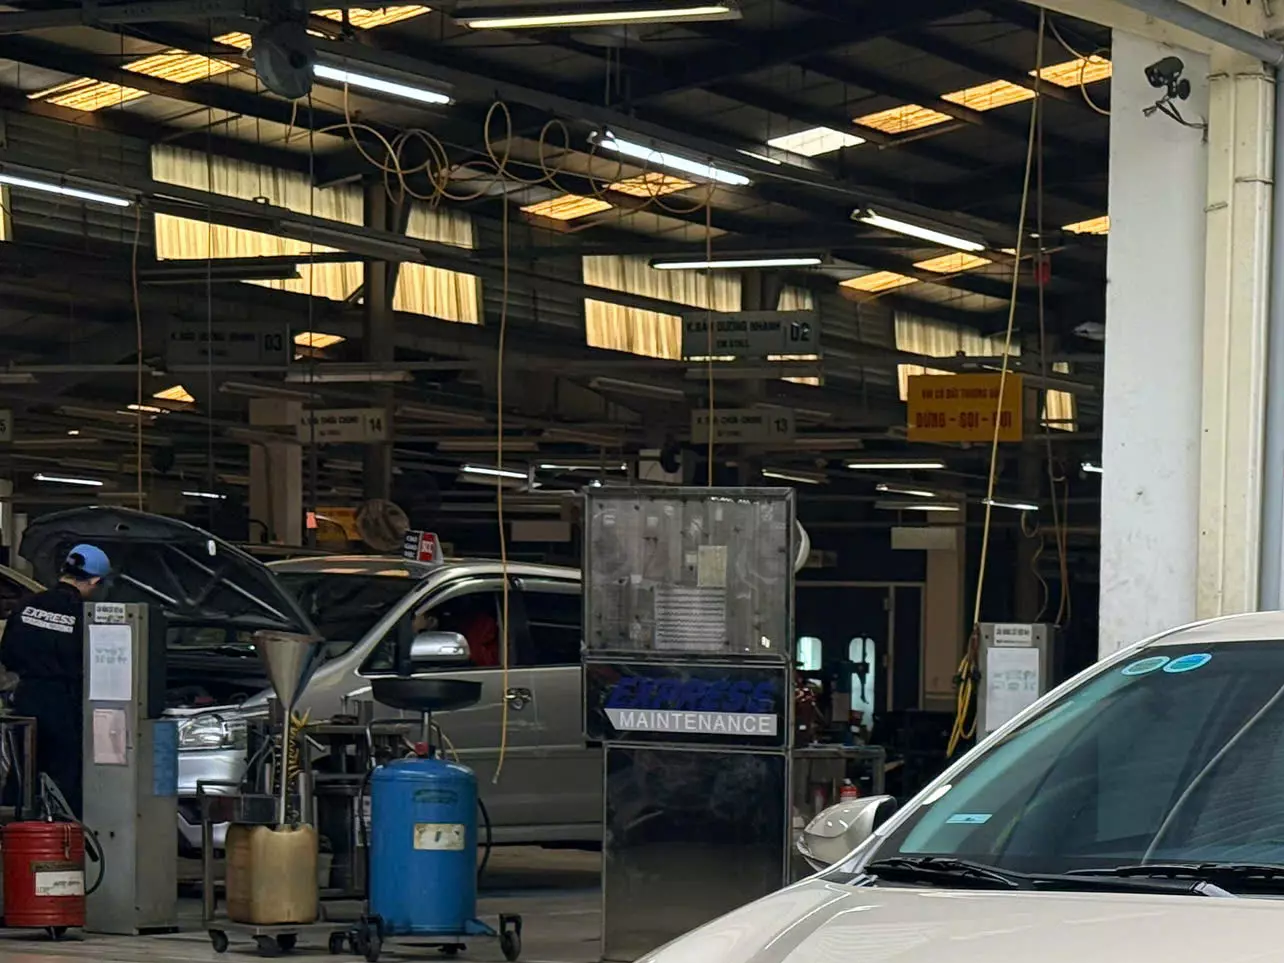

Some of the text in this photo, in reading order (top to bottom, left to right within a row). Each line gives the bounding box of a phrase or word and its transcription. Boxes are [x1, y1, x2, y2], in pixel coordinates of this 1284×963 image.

[773, 417, 788, 433] 13
[22, 606, 76, 625] EXPRESS
[619, 711, 772, 733] MAINTENANCE
